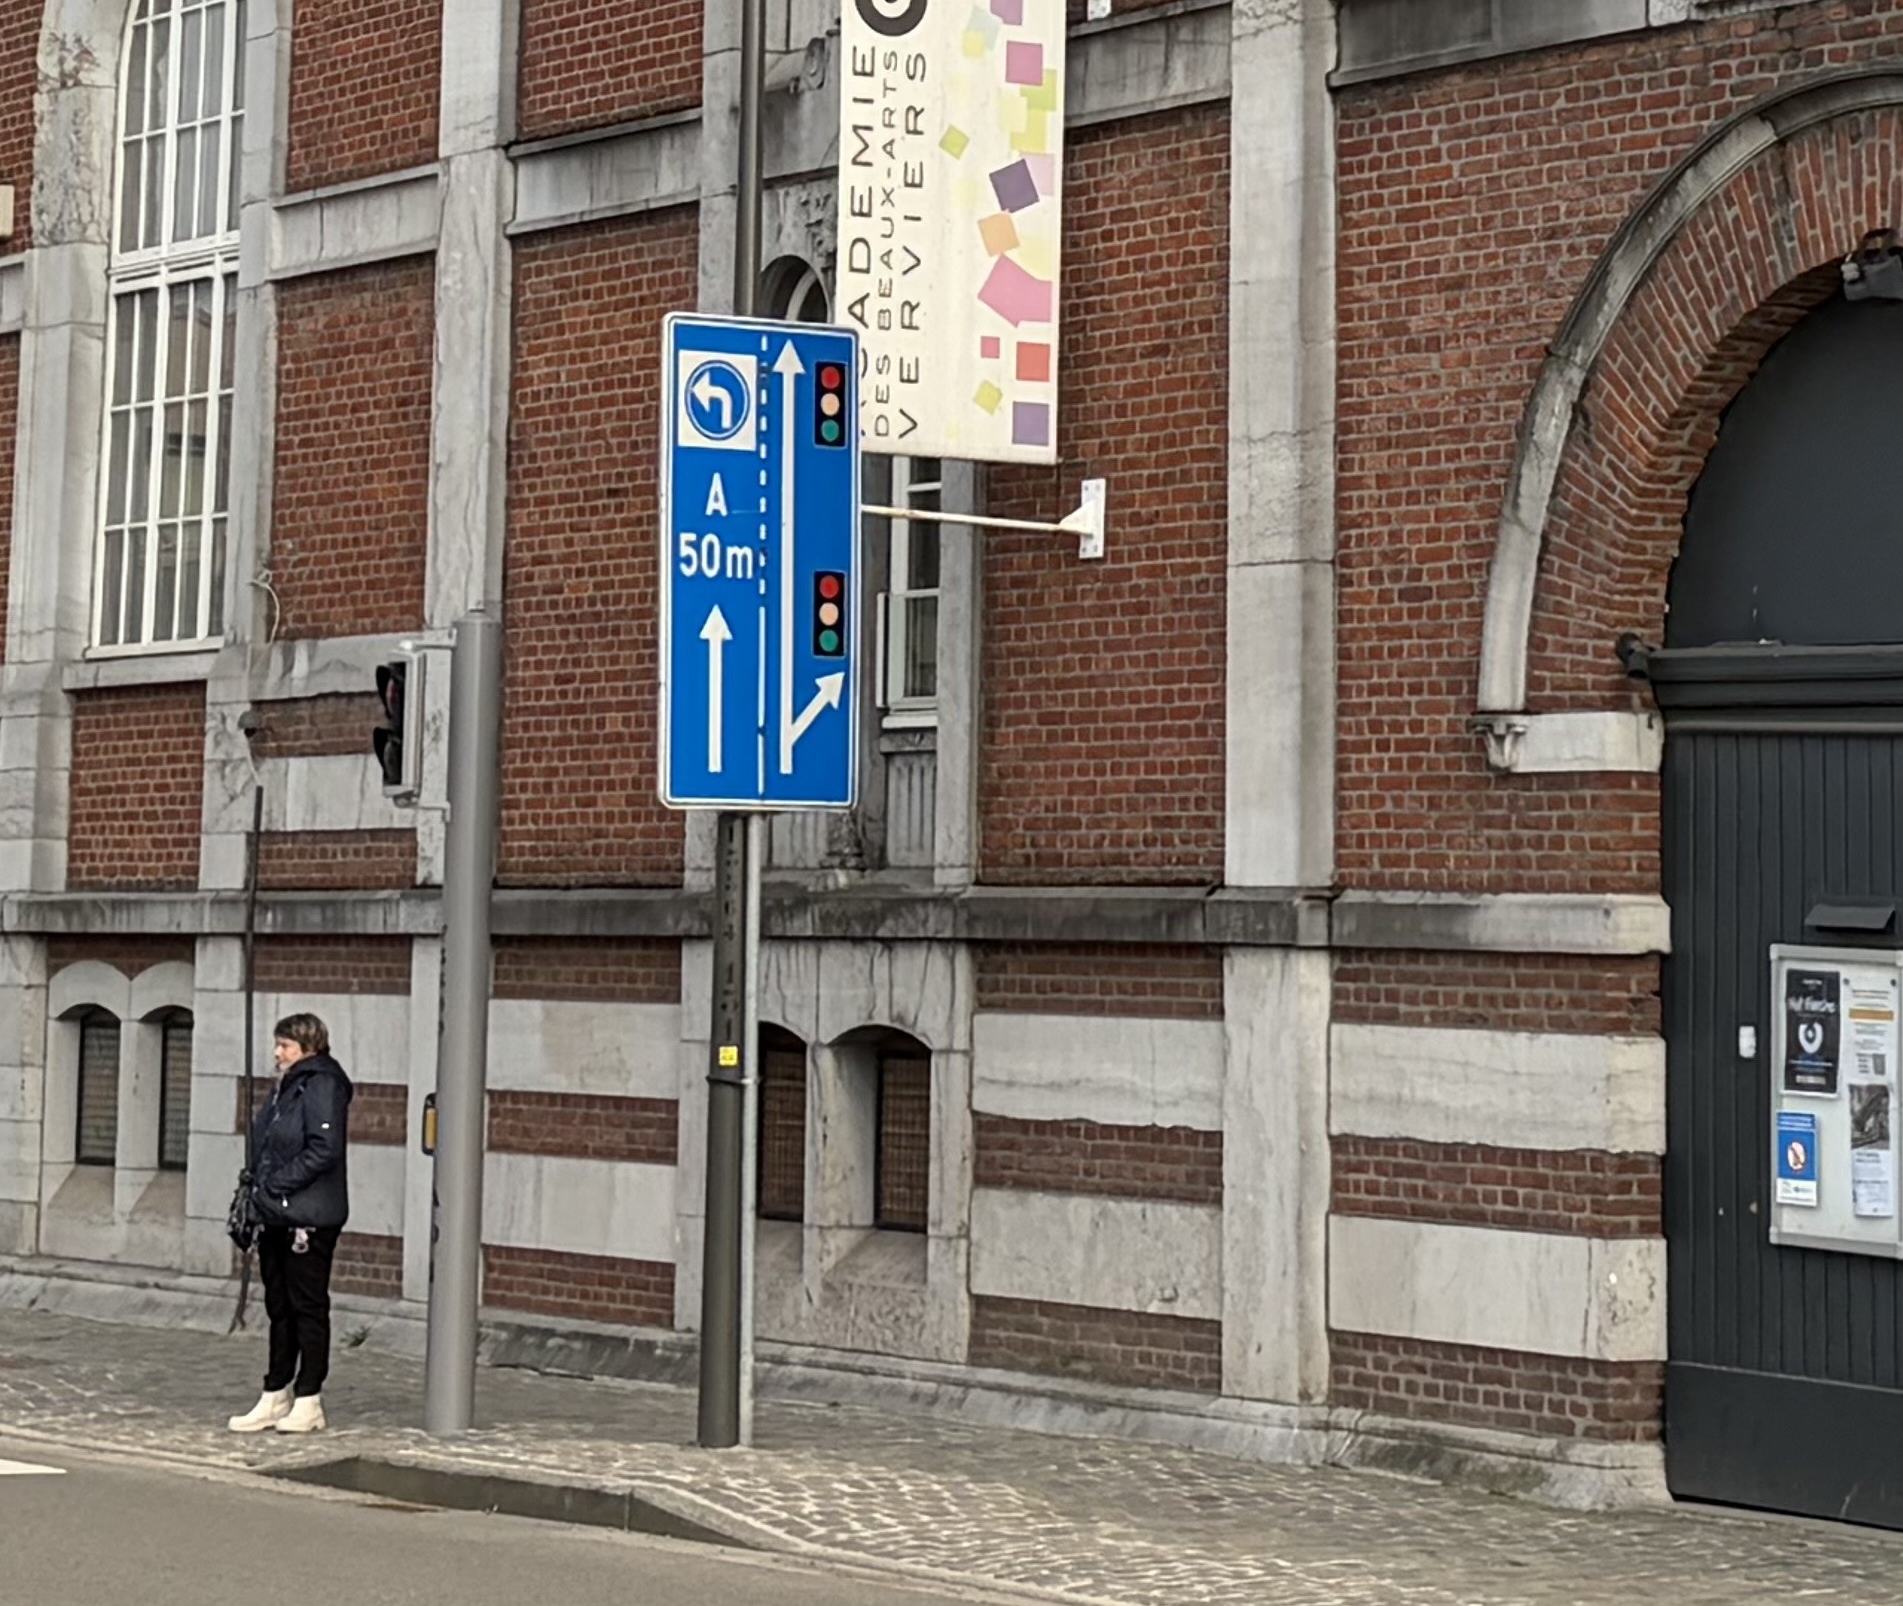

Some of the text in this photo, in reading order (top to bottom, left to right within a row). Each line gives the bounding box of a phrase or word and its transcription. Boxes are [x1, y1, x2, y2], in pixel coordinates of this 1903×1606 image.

[848, 45, 875, 436] ADEMIE
[874, 50, 898, 437] DES BEAUX-ARTS
[898, 52, 927, 440] VERVIERS
[705, 472, 728, 516] A
